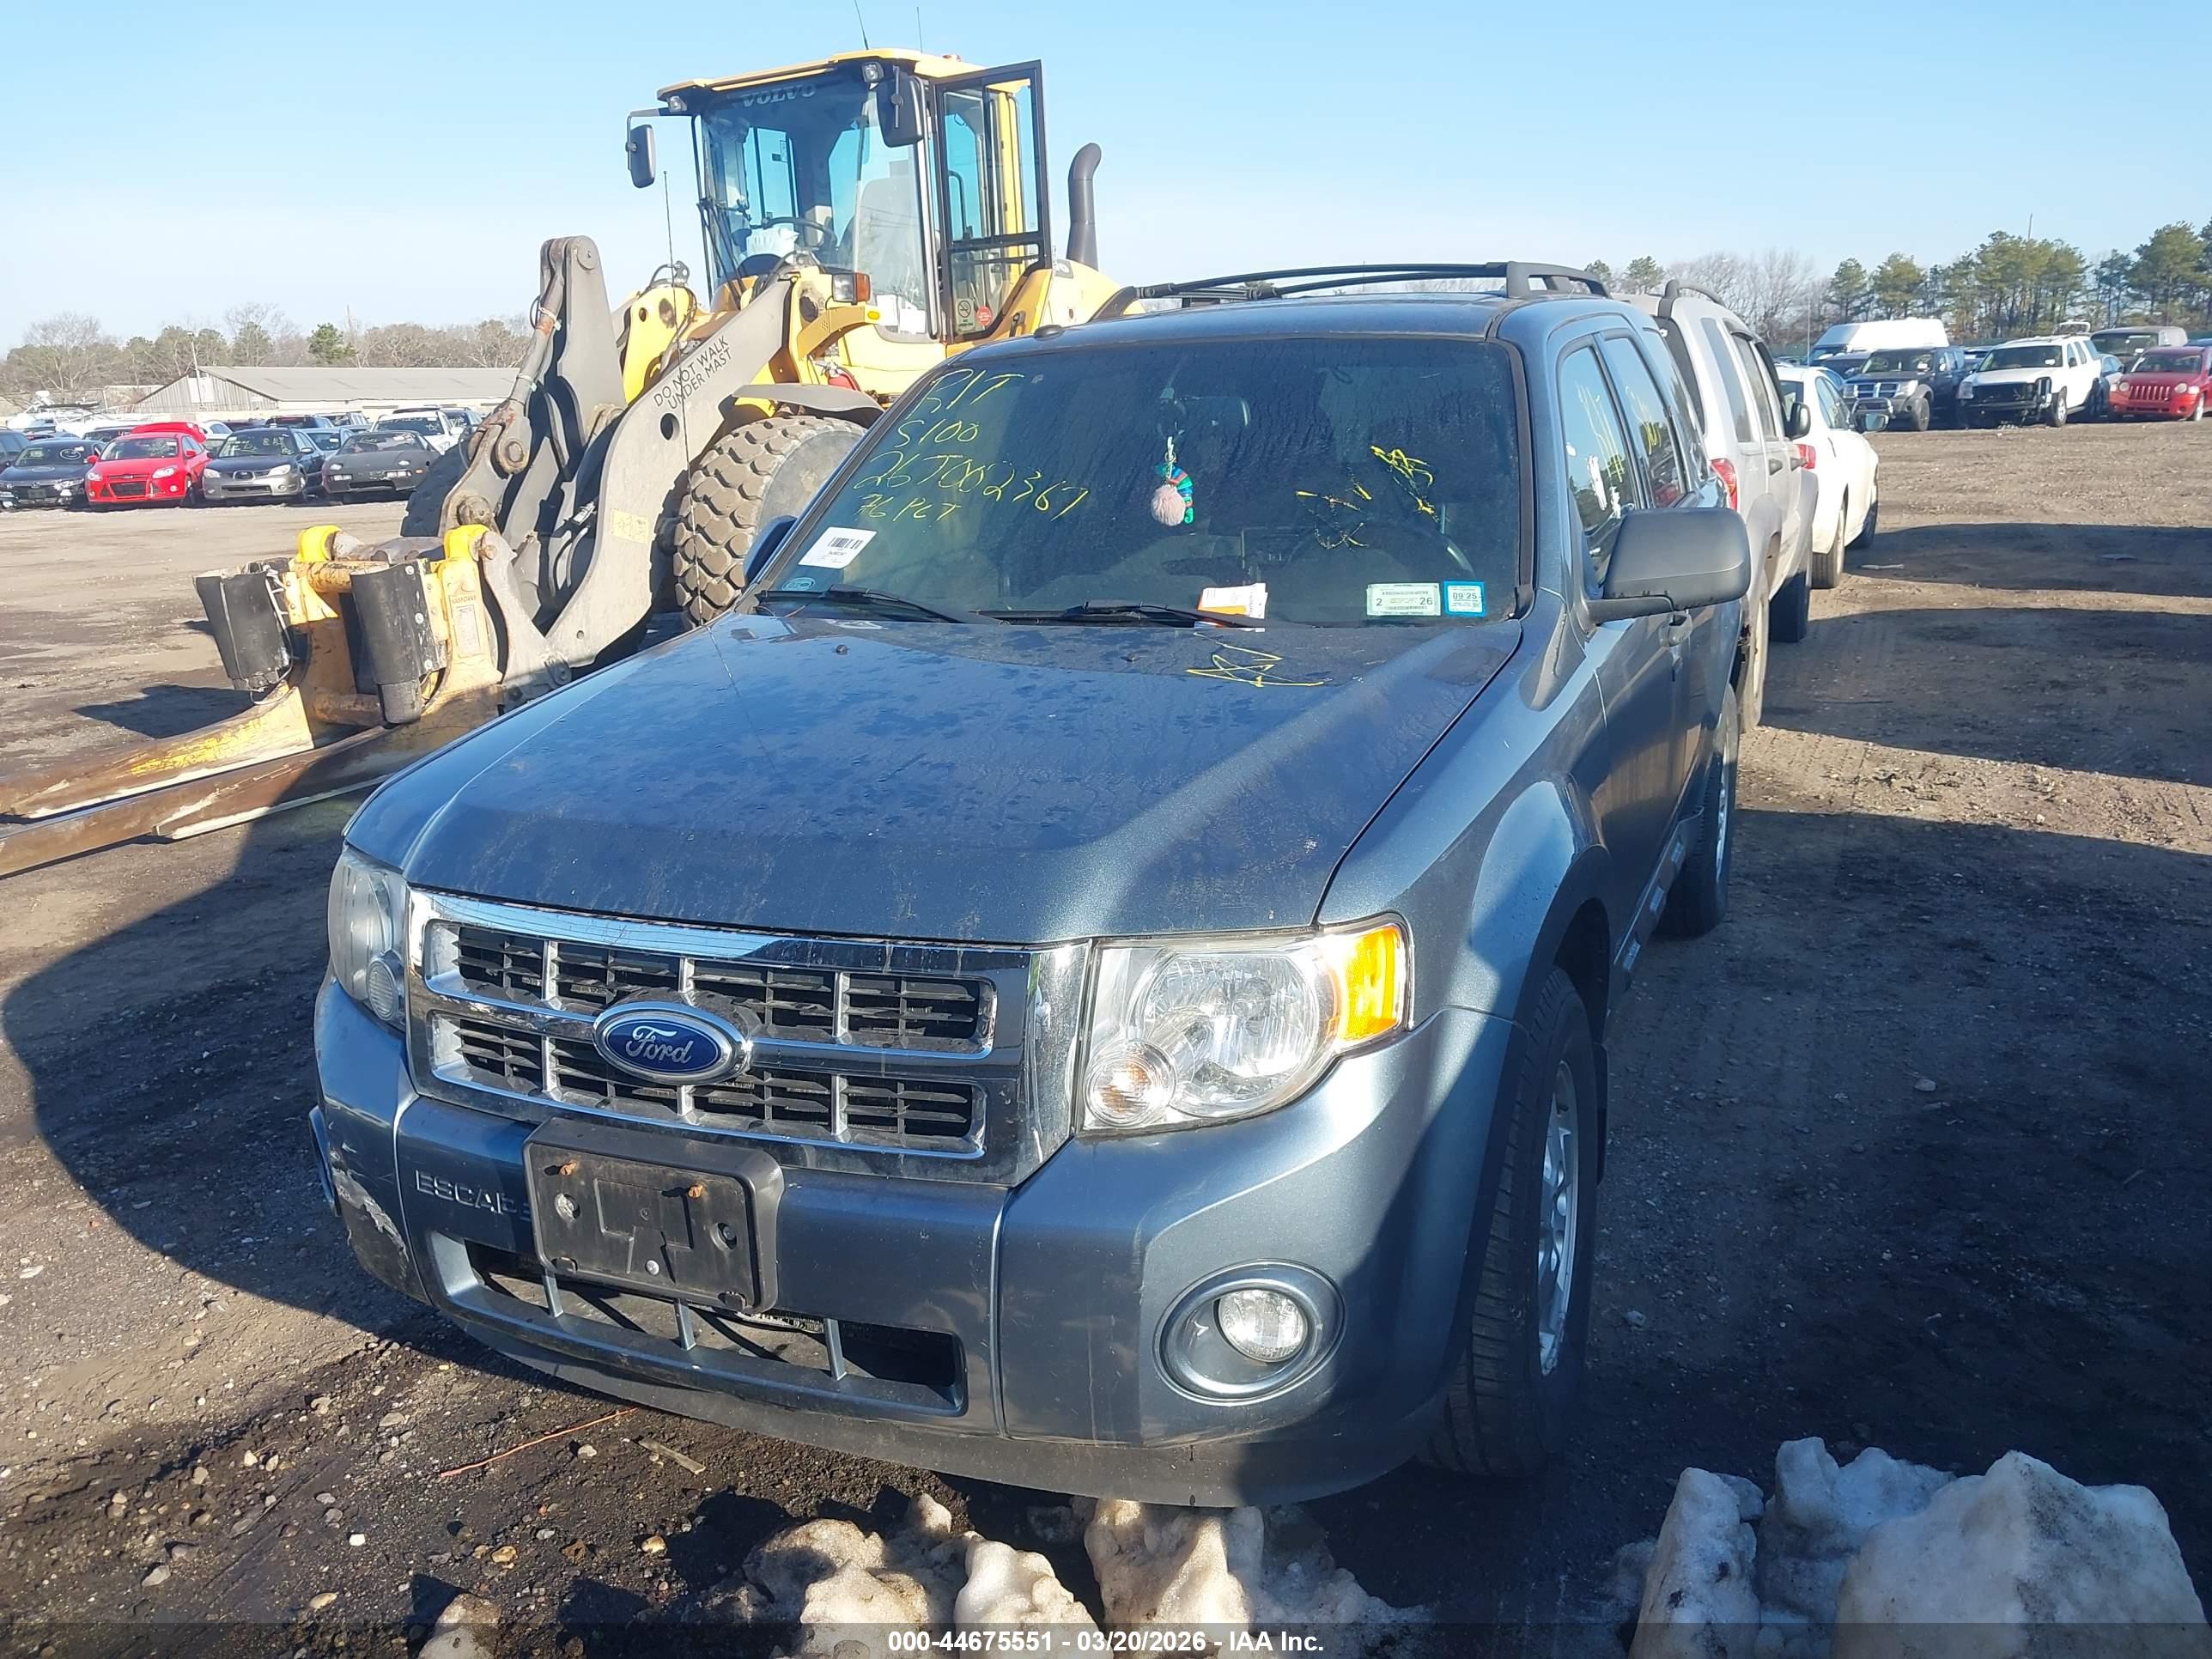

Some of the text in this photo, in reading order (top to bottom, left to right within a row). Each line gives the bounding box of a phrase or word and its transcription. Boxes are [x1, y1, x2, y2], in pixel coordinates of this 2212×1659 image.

[741, 83, 817, 107] VOLVO
[653, 336, 729, 407] DO NOT WALK
[667, 347, 732, 410] UNDER MAST
[1375, 598, 1383, 606] 2
[1419, 597, 1433, 605] 26
[625, 1025, 695, 1064] Ford
